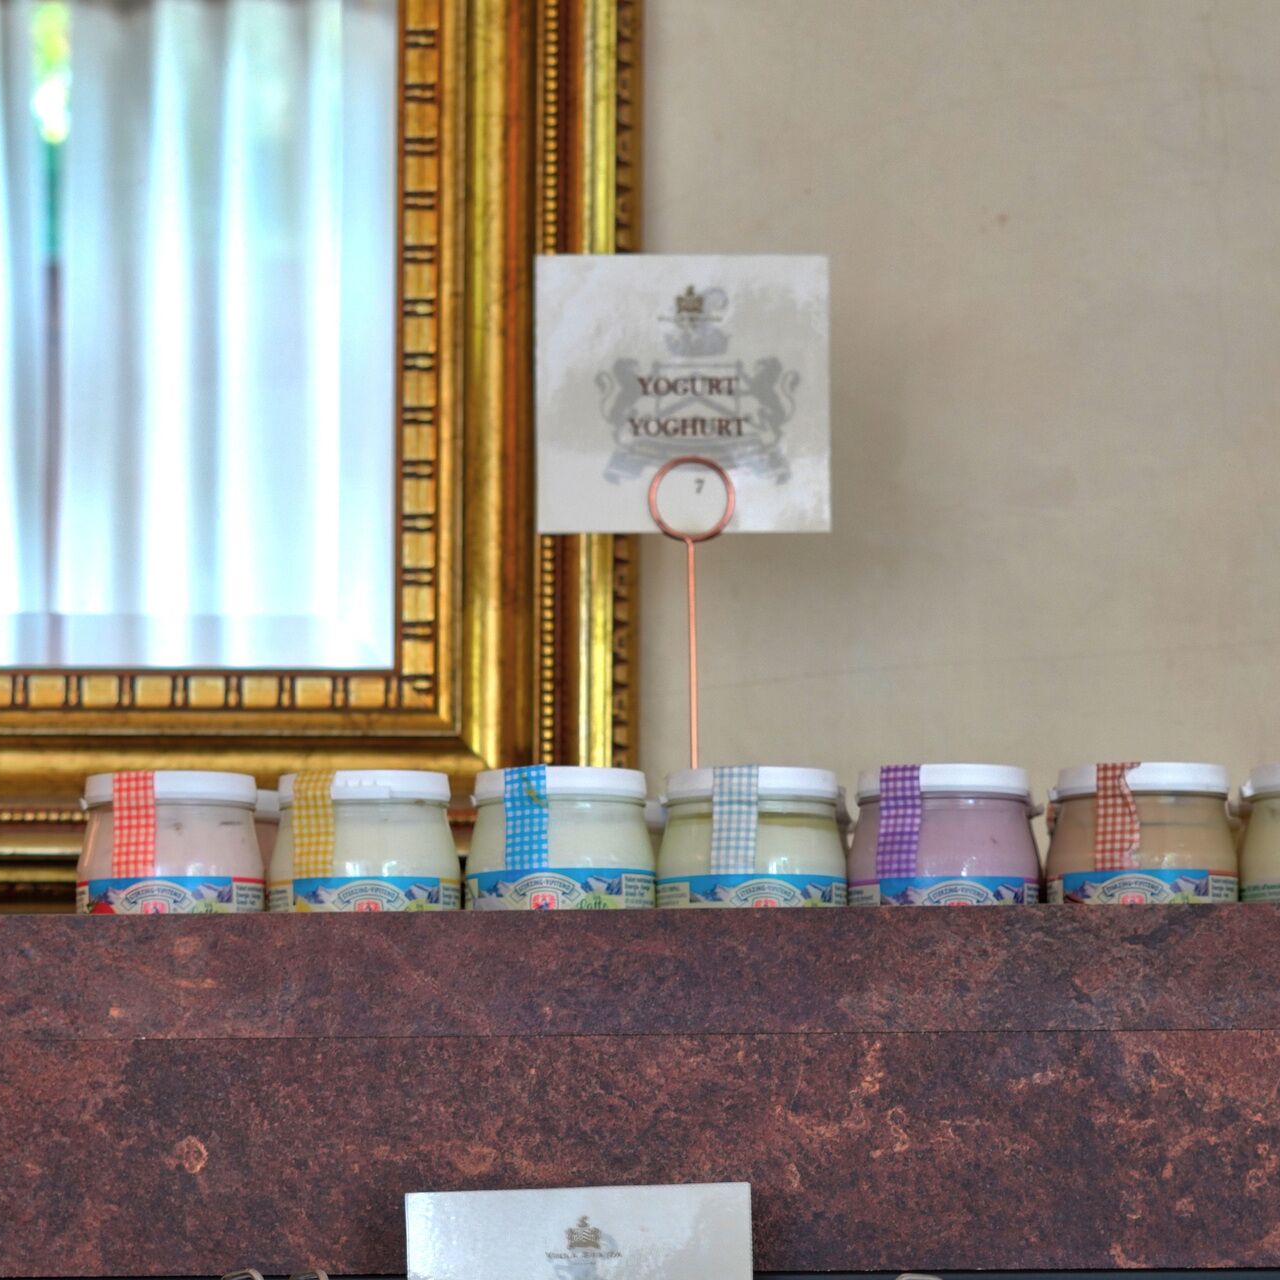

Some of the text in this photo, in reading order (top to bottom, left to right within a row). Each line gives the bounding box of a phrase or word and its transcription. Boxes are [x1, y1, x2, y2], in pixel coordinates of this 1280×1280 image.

[637, 376, 740, 396] YOGURT
[628, 416, 750, 437] YOGHURT
[694, 479, 705, 494] 7
